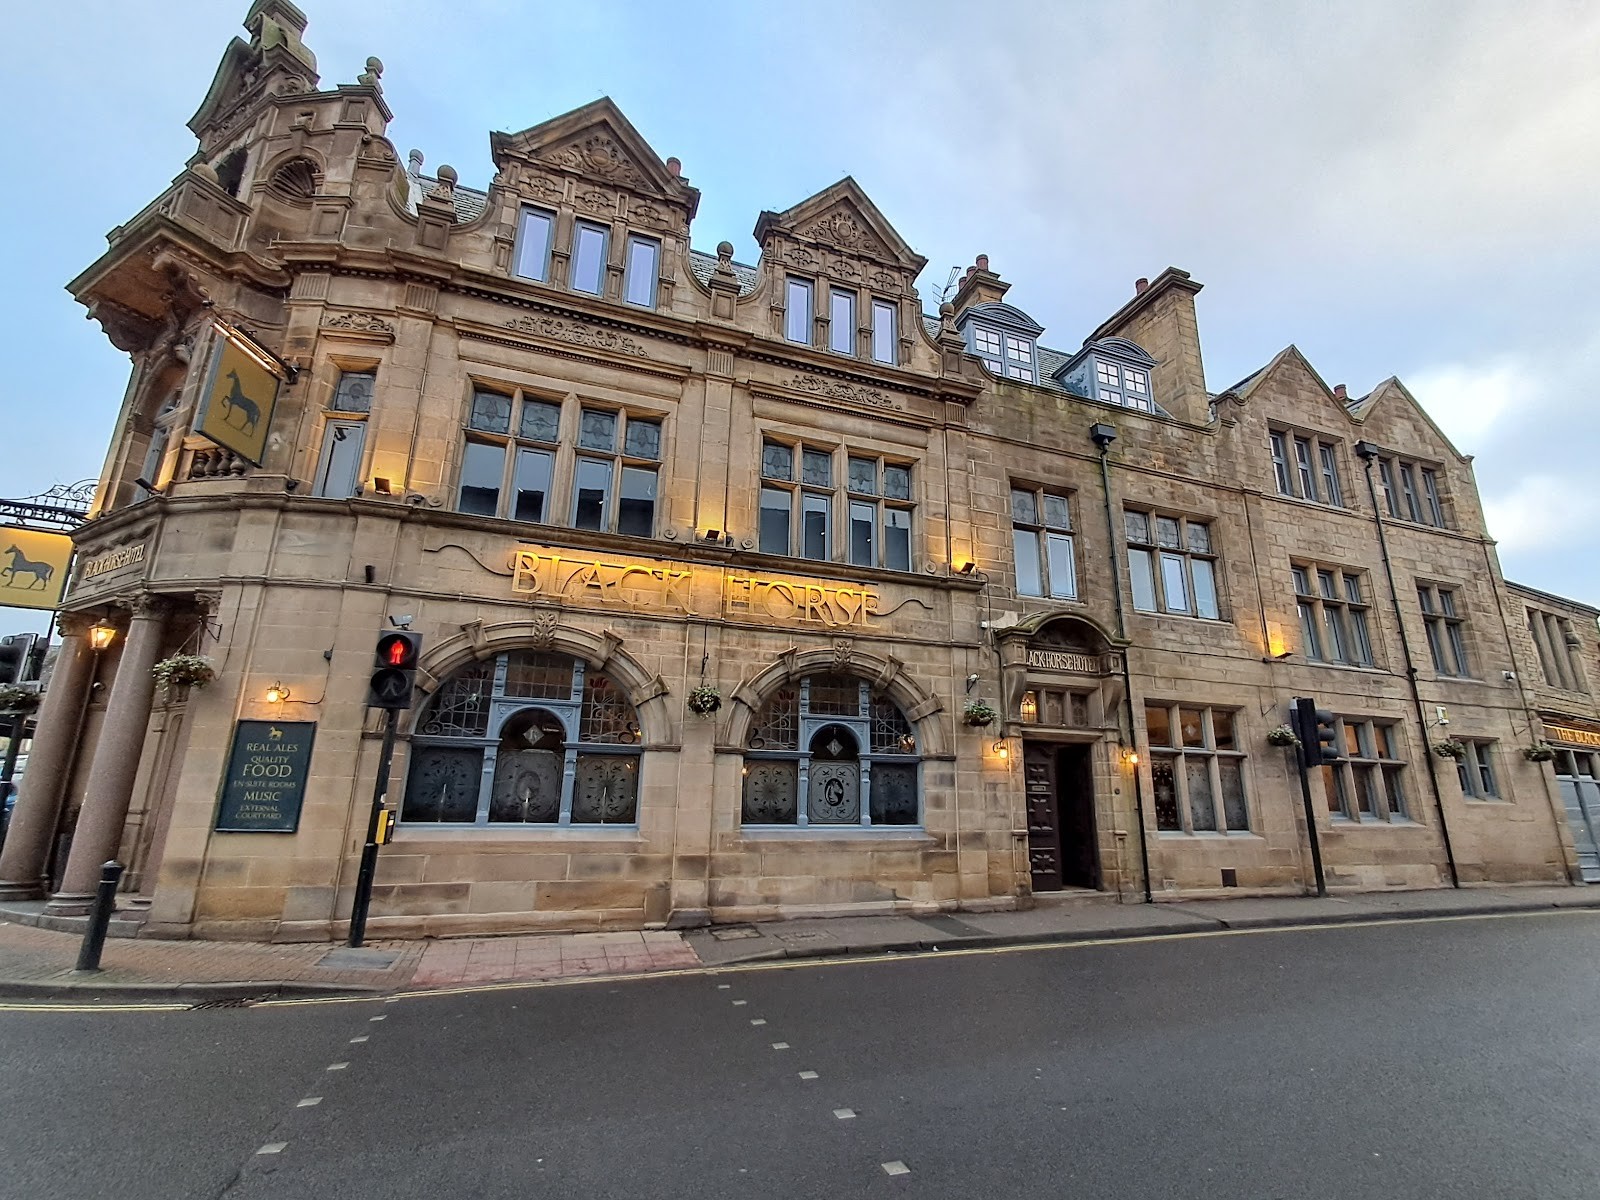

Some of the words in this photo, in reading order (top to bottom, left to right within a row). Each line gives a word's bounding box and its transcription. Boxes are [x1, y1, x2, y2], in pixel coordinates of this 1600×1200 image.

[511, 550, 699, 615] BLACK
[726, 575, 881, 628] HORSE
[1555, 728, 1574, 742] THE
[246, 742, 271, 752] REAL
[273, 743, 299, 753] ALES
[251, 756, 289, 764] QUALITY
[243, 763, 292, 778] FOOD
[268, 781, 297, 789] ROOMS
[243, 791, 281, 802] MUSIC
[239, 804, 279, 812] EXTERNAL
[235, 812, 282, 820] COURTYARD
